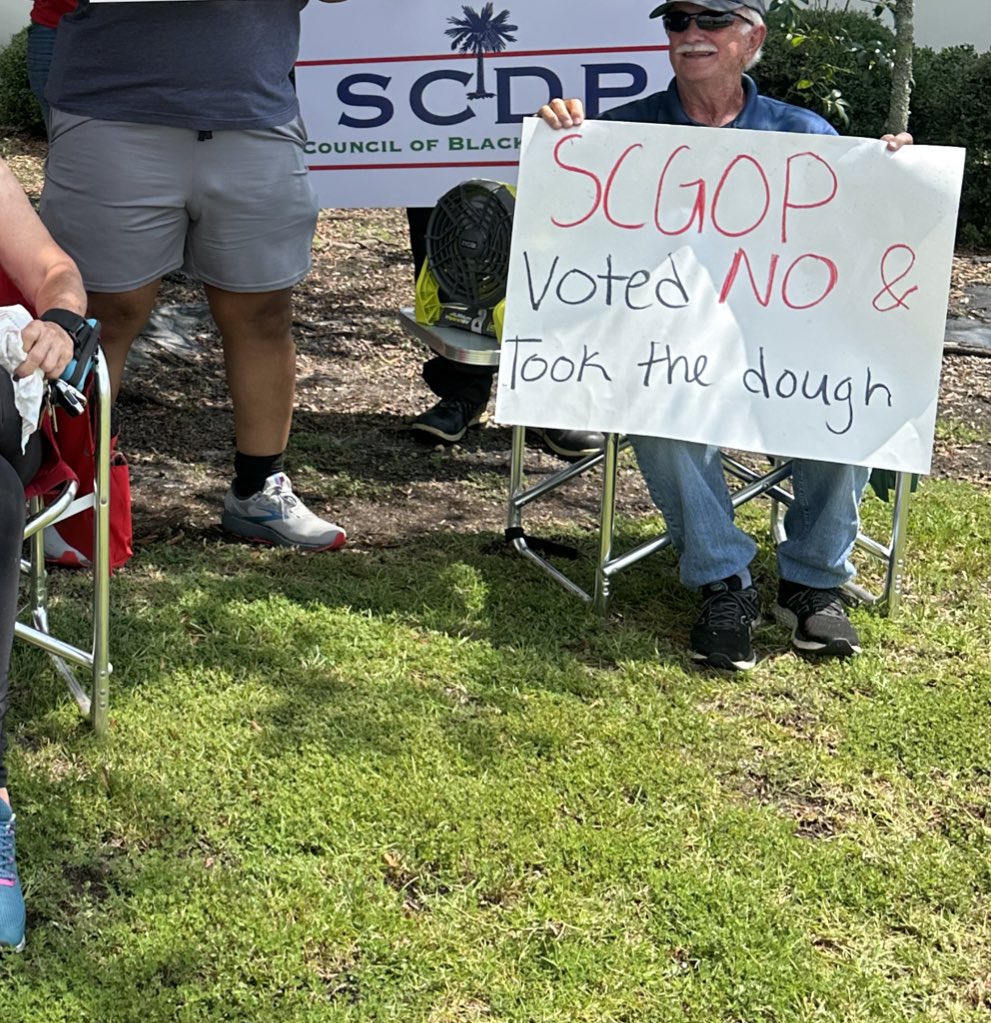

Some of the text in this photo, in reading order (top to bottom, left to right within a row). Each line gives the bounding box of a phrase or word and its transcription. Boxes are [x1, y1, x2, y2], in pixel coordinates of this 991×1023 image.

[337, 62, 648, 129] SCDP
[304, 140, 402, 155] COUNCIL
[410, 139, 439, 152] OF
[551, 133, 838, 243] SCGOP
[523, 244, 918, 312] Voted NO &
[505, 336, 891, 434] Took the dough
